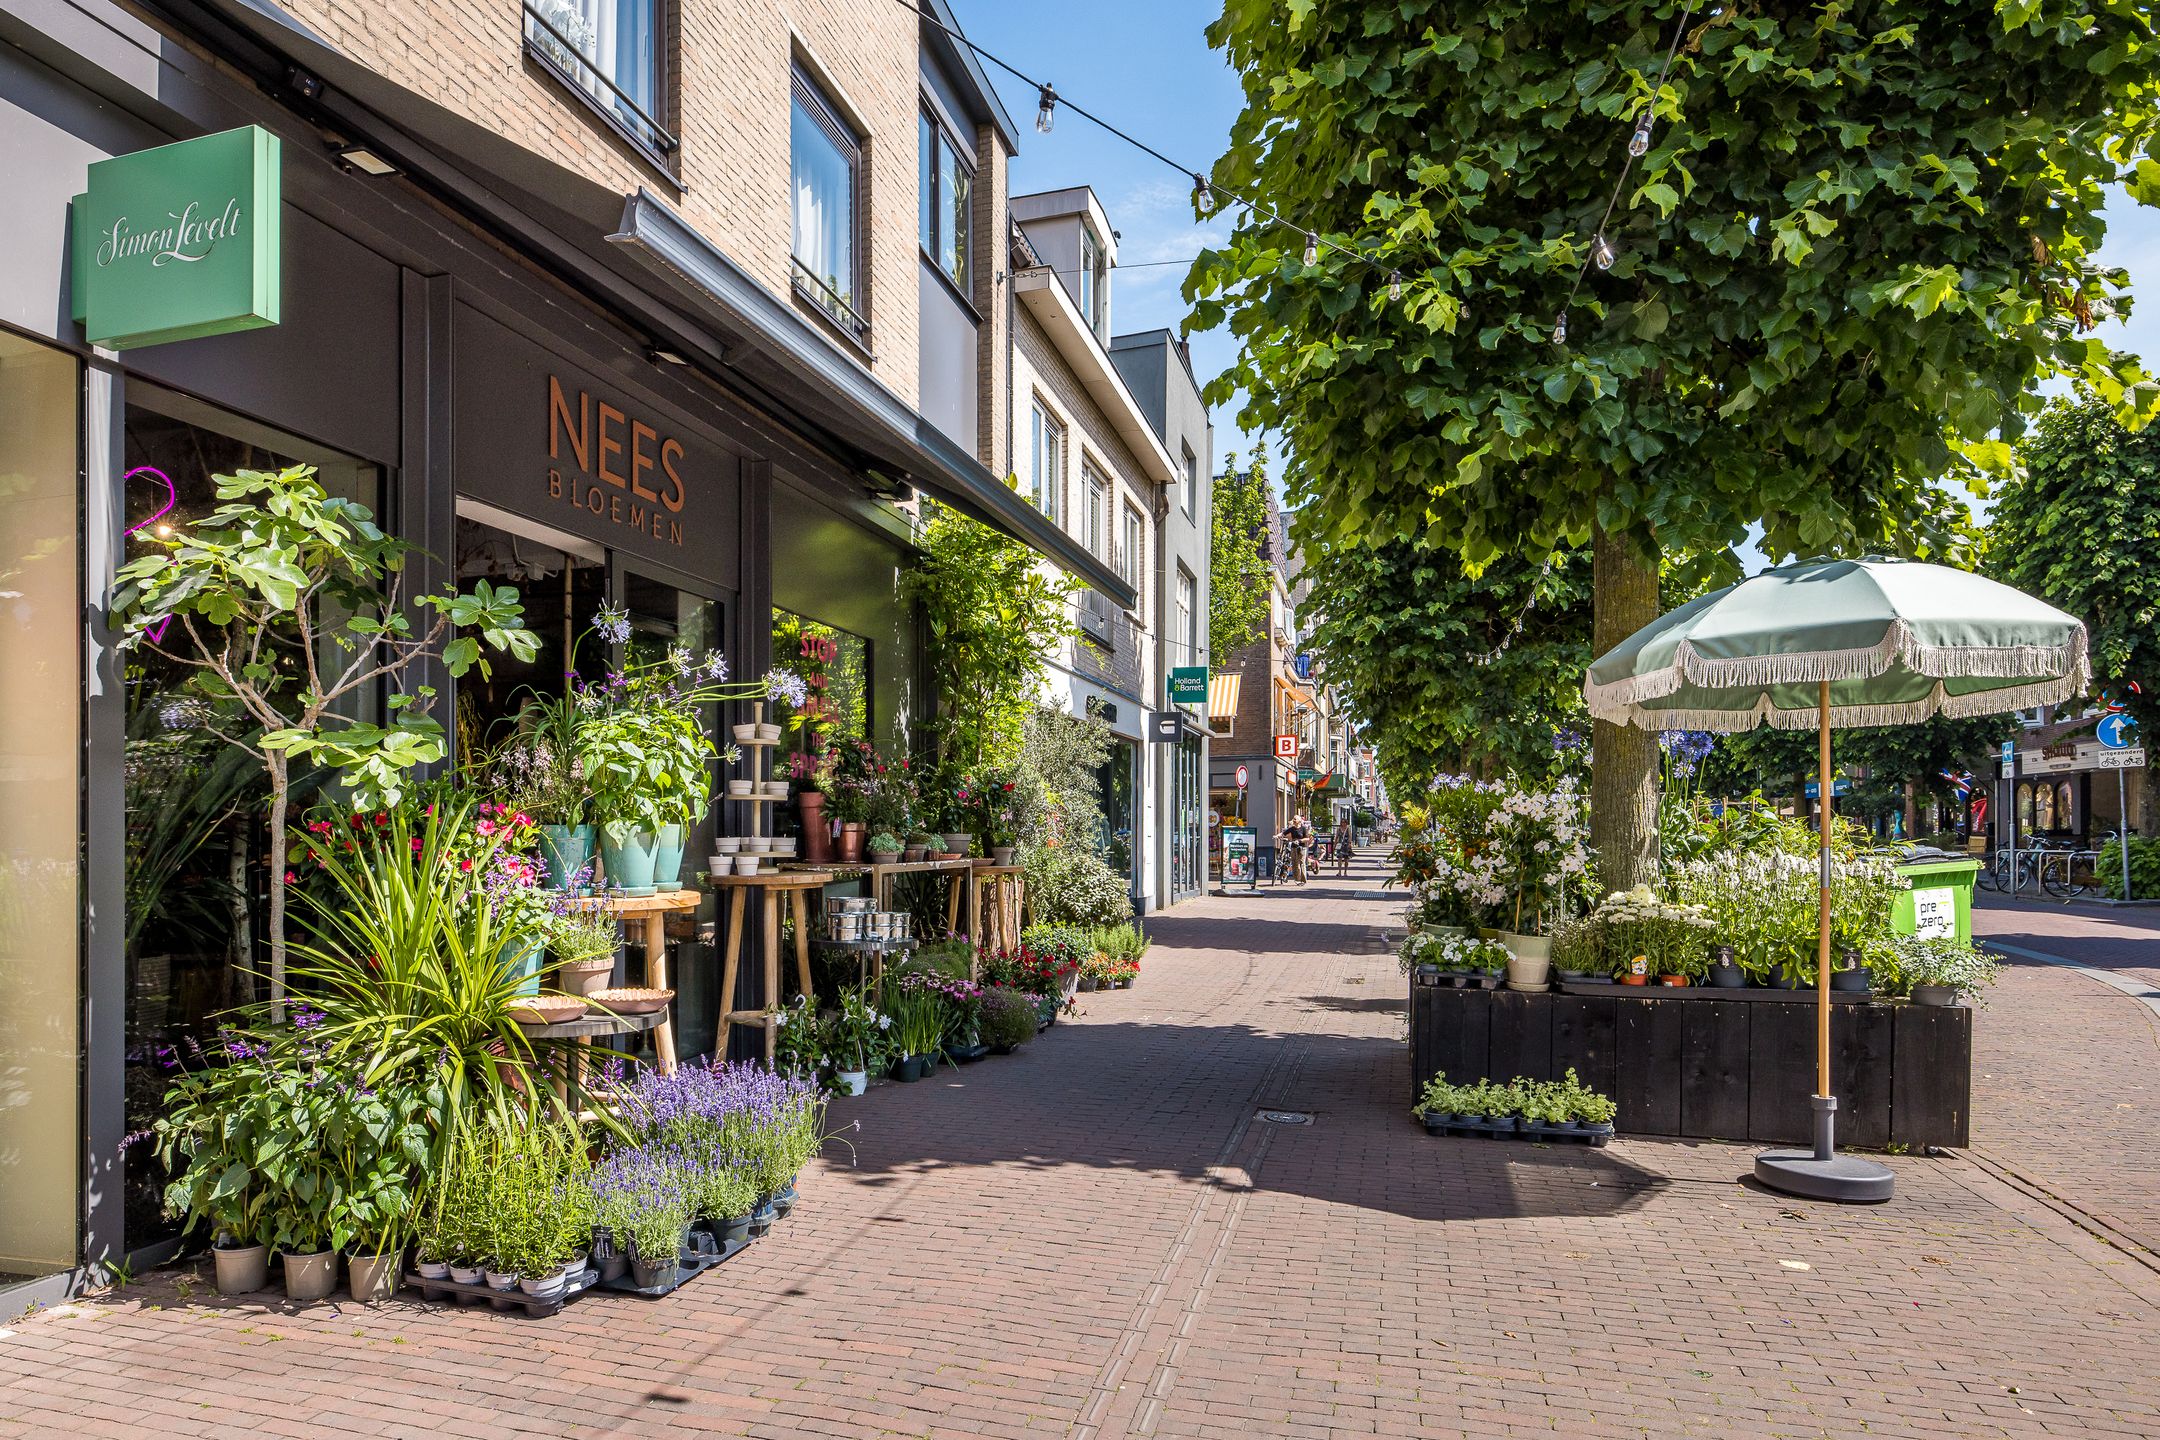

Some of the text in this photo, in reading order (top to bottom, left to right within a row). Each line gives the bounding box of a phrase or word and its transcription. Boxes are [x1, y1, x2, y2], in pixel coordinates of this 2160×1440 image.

[97, 217, 173, 267] Simon
[550, 375, 685, 513] NEES
[550, 468, 683, 547] BLOEMEN
[800, 630, 837, 664] STOP
[1174, 677, 1201, 685] Holland
[1281, 739, 1292, 752] B
[2100, 749, 2144, 757] uitgezonderd
[1920, 902, 1937, 916] pre
[1921, 916, 1944, 928] zero
